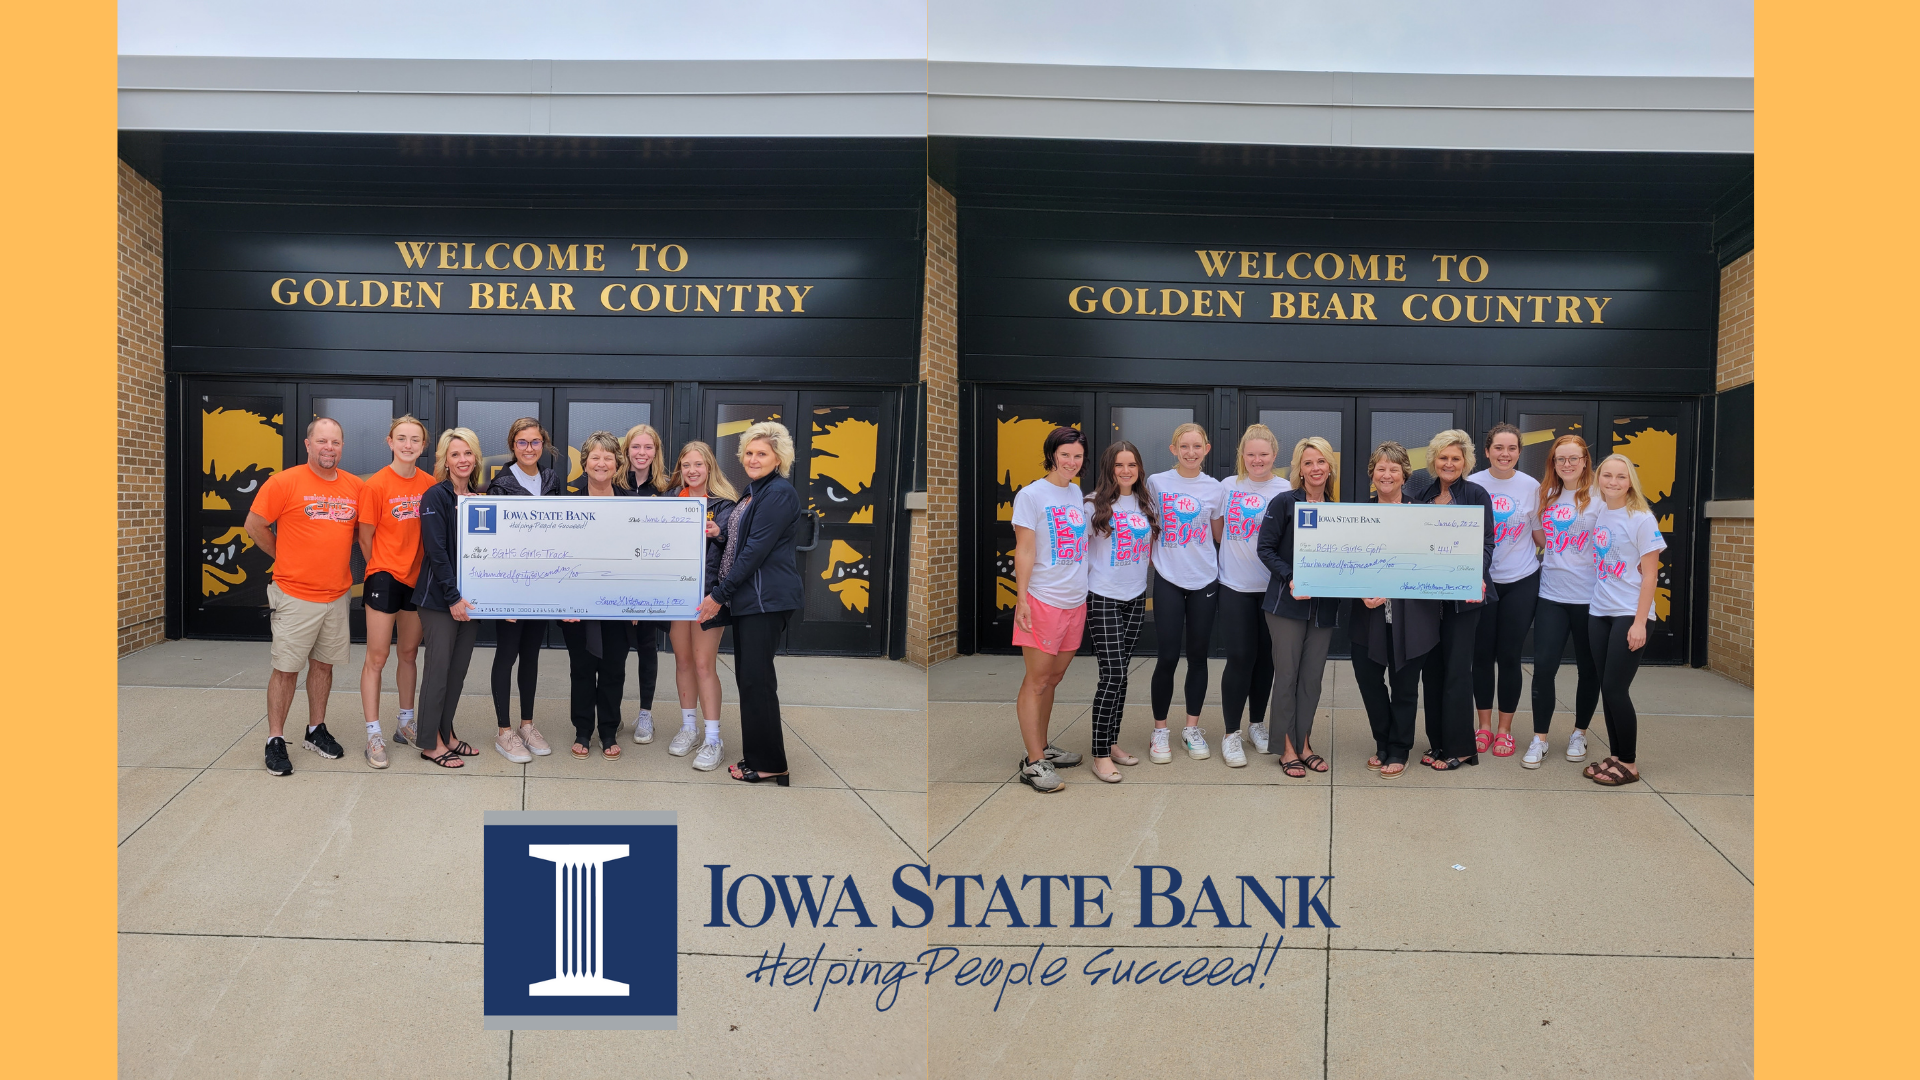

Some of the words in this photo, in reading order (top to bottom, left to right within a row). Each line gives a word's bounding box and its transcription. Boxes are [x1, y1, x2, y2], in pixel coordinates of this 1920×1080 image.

[395, 241, 605, 272] WELCOME
[630, 243, 689, 273] TO
[1195, 250, 1406, 282] WELCOME
[1431, 254, 1489, 283] TO
[271, 278, 444, 309] GOLDEN
[468, 282, 575, 311] BEAR
[600, 283, 814, 314] COUNTRY
[1068, 285, 1245, 319] GOLDEN
[1269, 291, 1377, 321] BEAR
[1401, 293, 1612, 324] COUNTRY
[503, 510, 528, 520] IOWA
[530, 510, 563, 520] STATE
[566, 510, 596, 521] BANK
[1163, 493, 1178, 542] STATE
[1228, 492, 1247, 534] STATE
[509, 522, 534, 532] Helping
[534, 522, 556, 532] People
[1051, 507, 1075, 559] STATE
[1113, 512, 1132, 560] STATE
[1178, 523, 1207, 545] Golf
[1494, 522, 1525, 543] Golf
[542, 549, 573, 559] Track
[635, 548, 640, 557] $
[643, 549, 661, 557] 546
[1555, 531, 1589, 553] Golf
